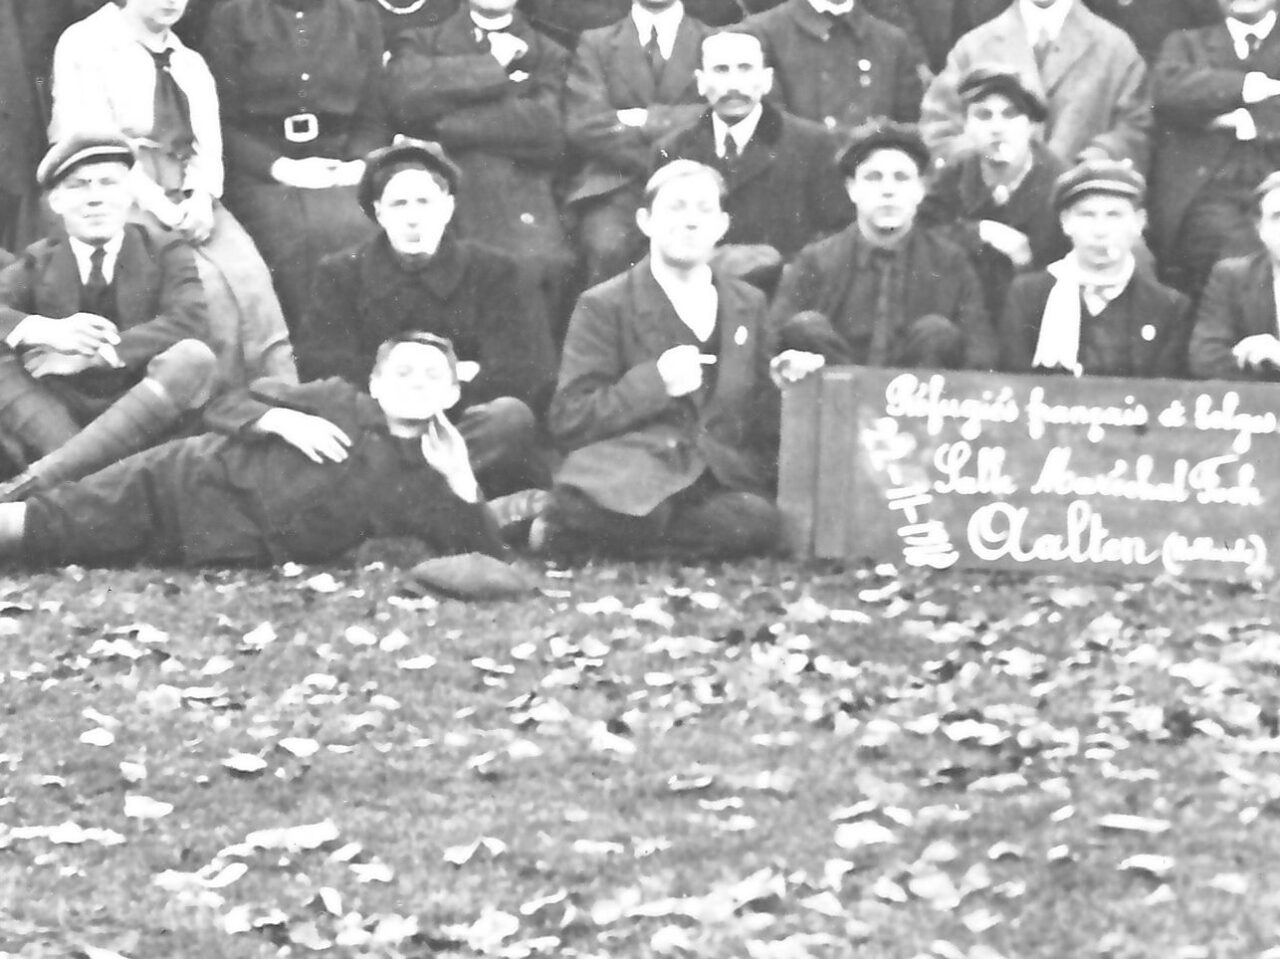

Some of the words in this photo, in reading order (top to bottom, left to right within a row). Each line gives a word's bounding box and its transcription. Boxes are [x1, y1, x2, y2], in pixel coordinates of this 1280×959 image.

[885, 373, 1019, 440] Réfugiés
[933, 441, 1017, 495] Salle
[967, 500, 1160, 565] Aalten
